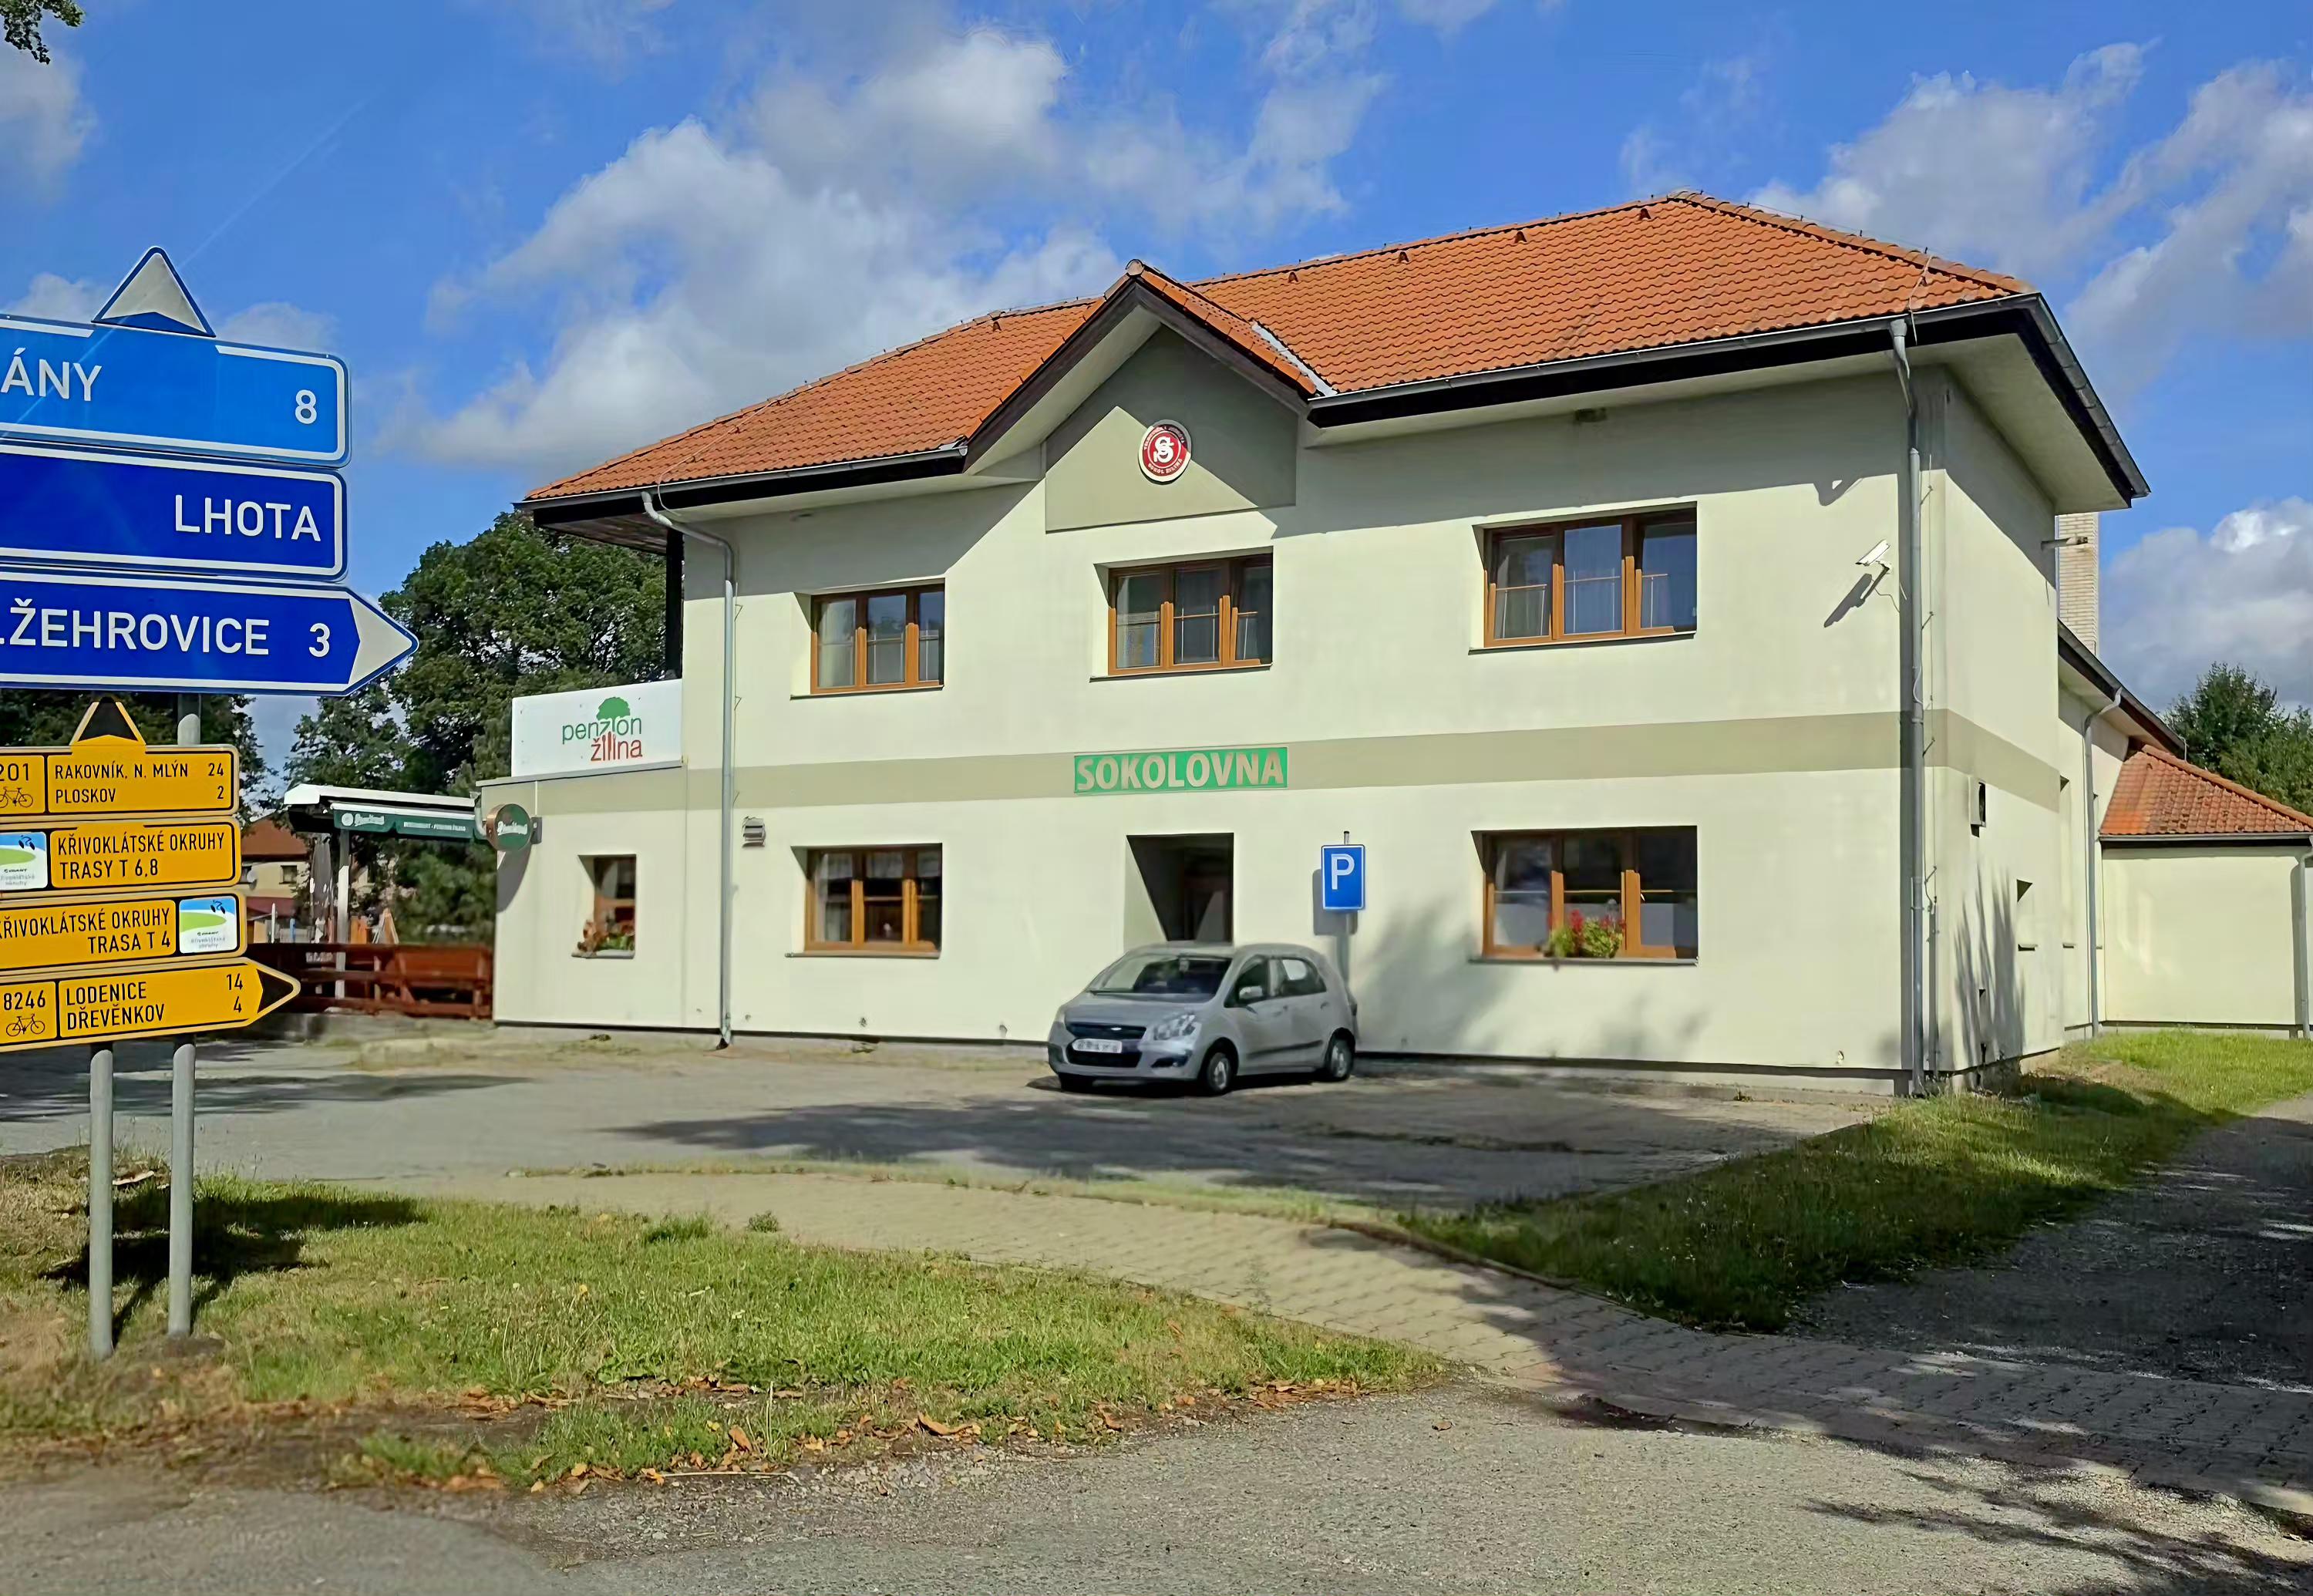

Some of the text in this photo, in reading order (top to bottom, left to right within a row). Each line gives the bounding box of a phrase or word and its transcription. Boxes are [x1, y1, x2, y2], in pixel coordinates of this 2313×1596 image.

[0, 347, 318, 425] ÁNY 8
[174, 494, 322, 542] LHOTA
[308, 622, 331, 658] 3
[562, 716, 642, 745] penzion
[591, 731, 643, 762] žilina
[134, 764, 147, 779] N.
[153, 760, 188, 778] MLÝN
[207, 763, 224, 776] 24
[1076, 750, 1284, 790] SOKOLOVNA
[56, 785, 224, 803] PLOSKOV 2
[58, 830, 225, 855] KŘIVOKLÁTSKÉ OKRUHY
[59, 858, 159, 880] TRASY T 6,8
[1331, 854, 1355, 891] P
[0, 907, 170, 939] ŘIVOKLÁTSKÉ OKRUHY
[87, 930, 170, 955] TRASA T 4
[3, 989, 46, 1011] 8246
[66, 972, 243, 1006] LODENICE 14
[67, 995, 242, 1031] DŘEVĚNKOV 4
